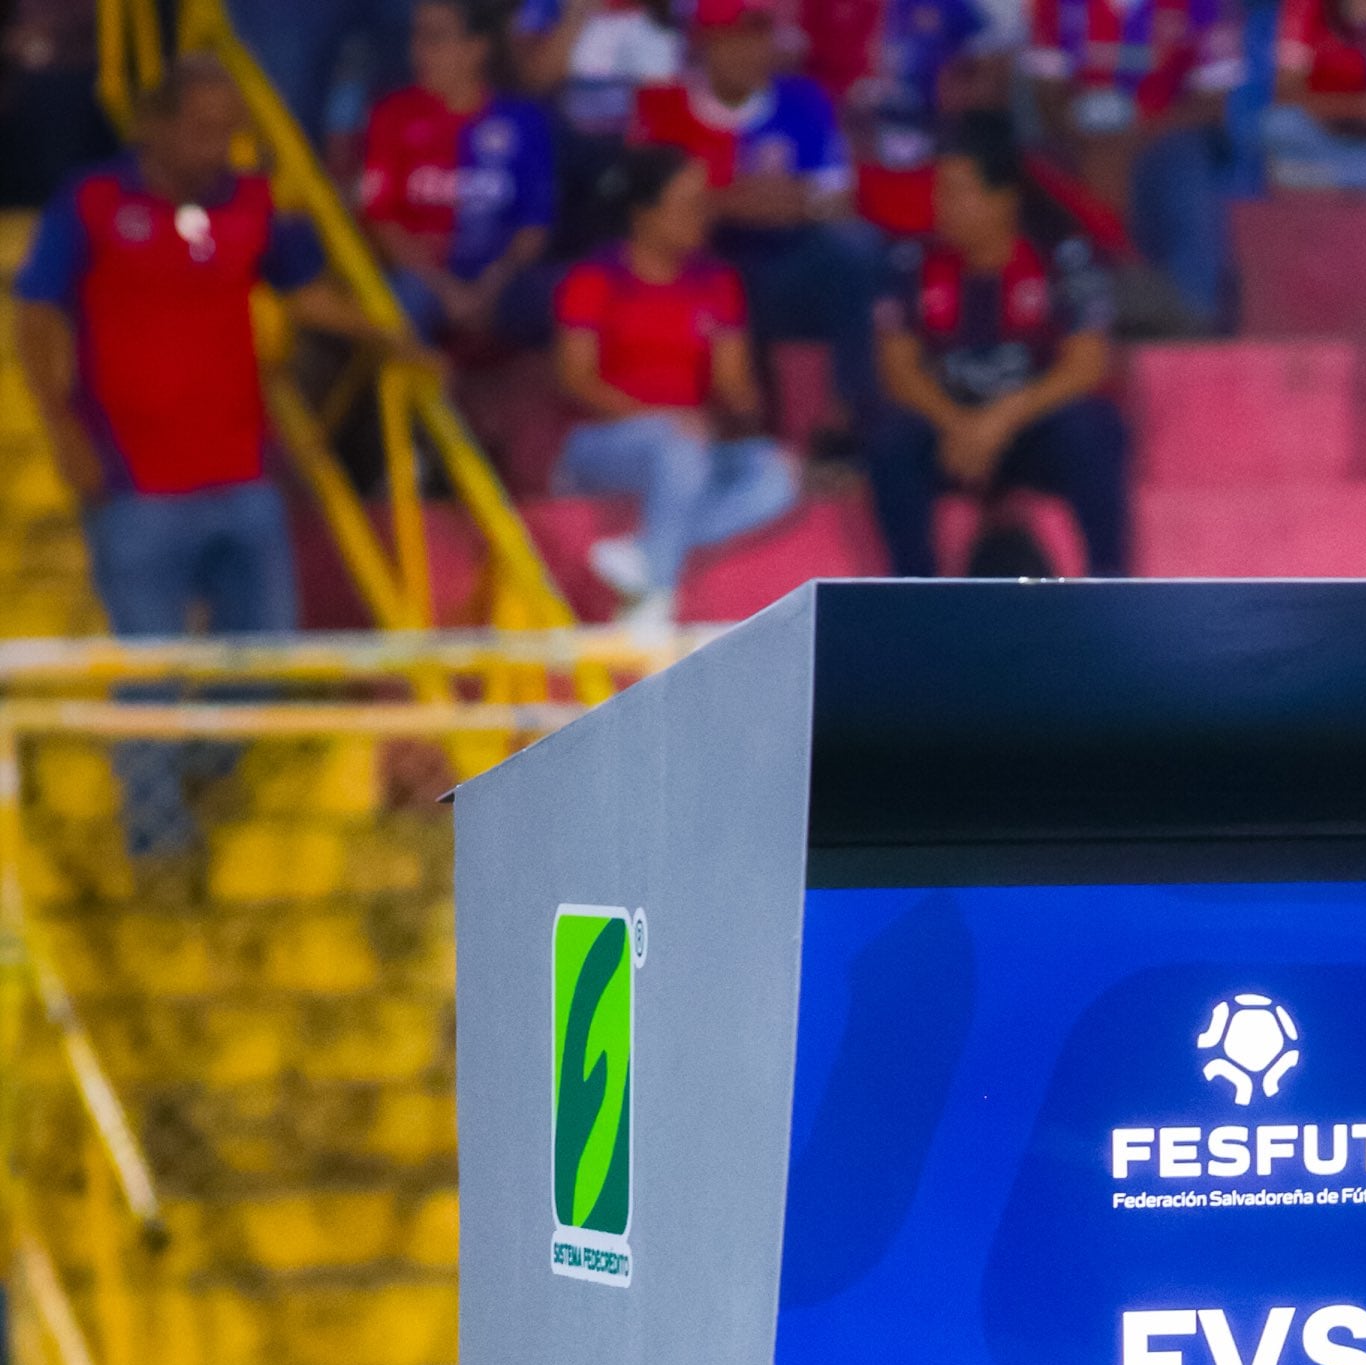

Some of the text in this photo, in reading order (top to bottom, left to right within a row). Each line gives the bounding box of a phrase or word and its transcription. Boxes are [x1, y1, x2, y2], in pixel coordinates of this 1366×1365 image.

[1113, 1190, 1208, 1209] Federación
[1209, 1188, 1315, 1208] Salvadoreña
[1316, 1187, 1340, 1205] de
